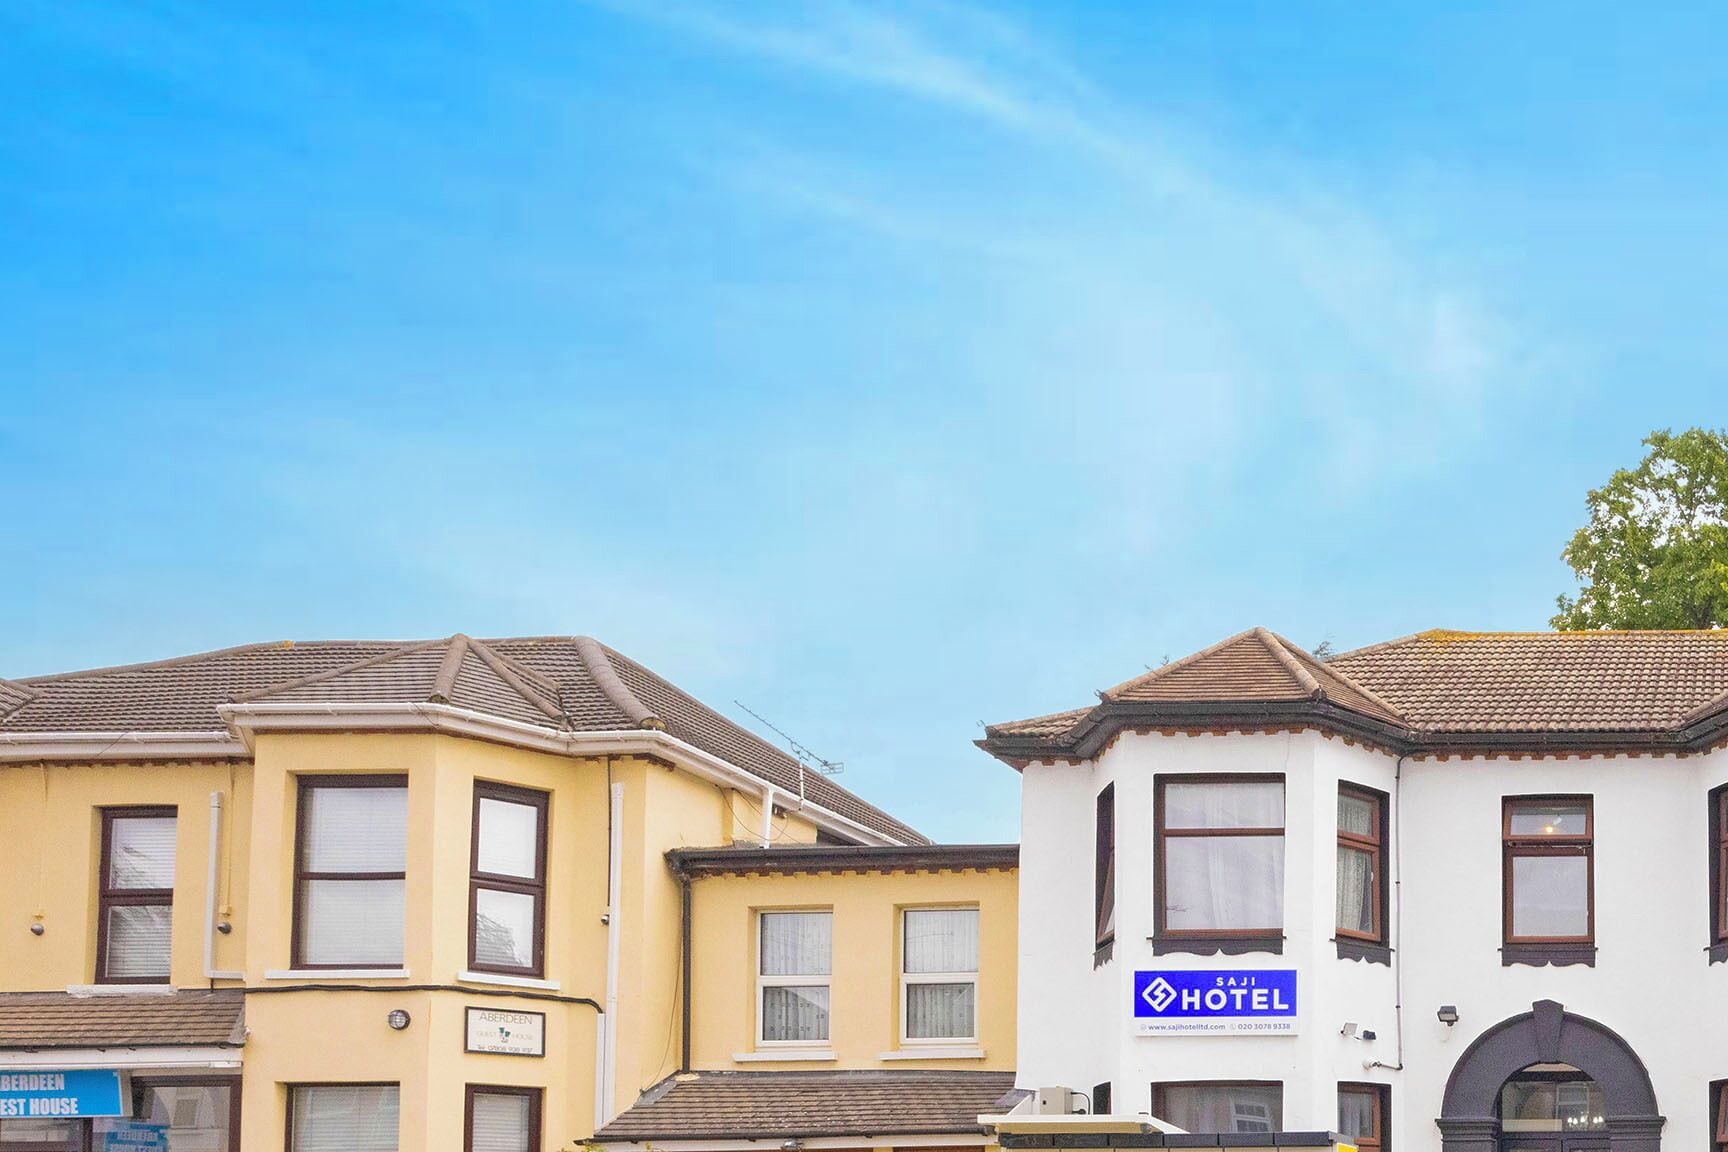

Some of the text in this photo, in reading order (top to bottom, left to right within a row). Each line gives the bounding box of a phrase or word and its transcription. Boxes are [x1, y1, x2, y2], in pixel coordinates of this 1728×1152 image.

[1216, 977, 1255, 986] SAJI
[1182, 989, 1289, 1011] HOTEL
[480, 1012, 532, 1024] ABERDEEN
[1148, 1023, 1225, 1031] www.sajihotelltd.com
[0, 1074, 64, 1091] BERDEEN
[0, 1097, 79, 1115] EST HOUSE
